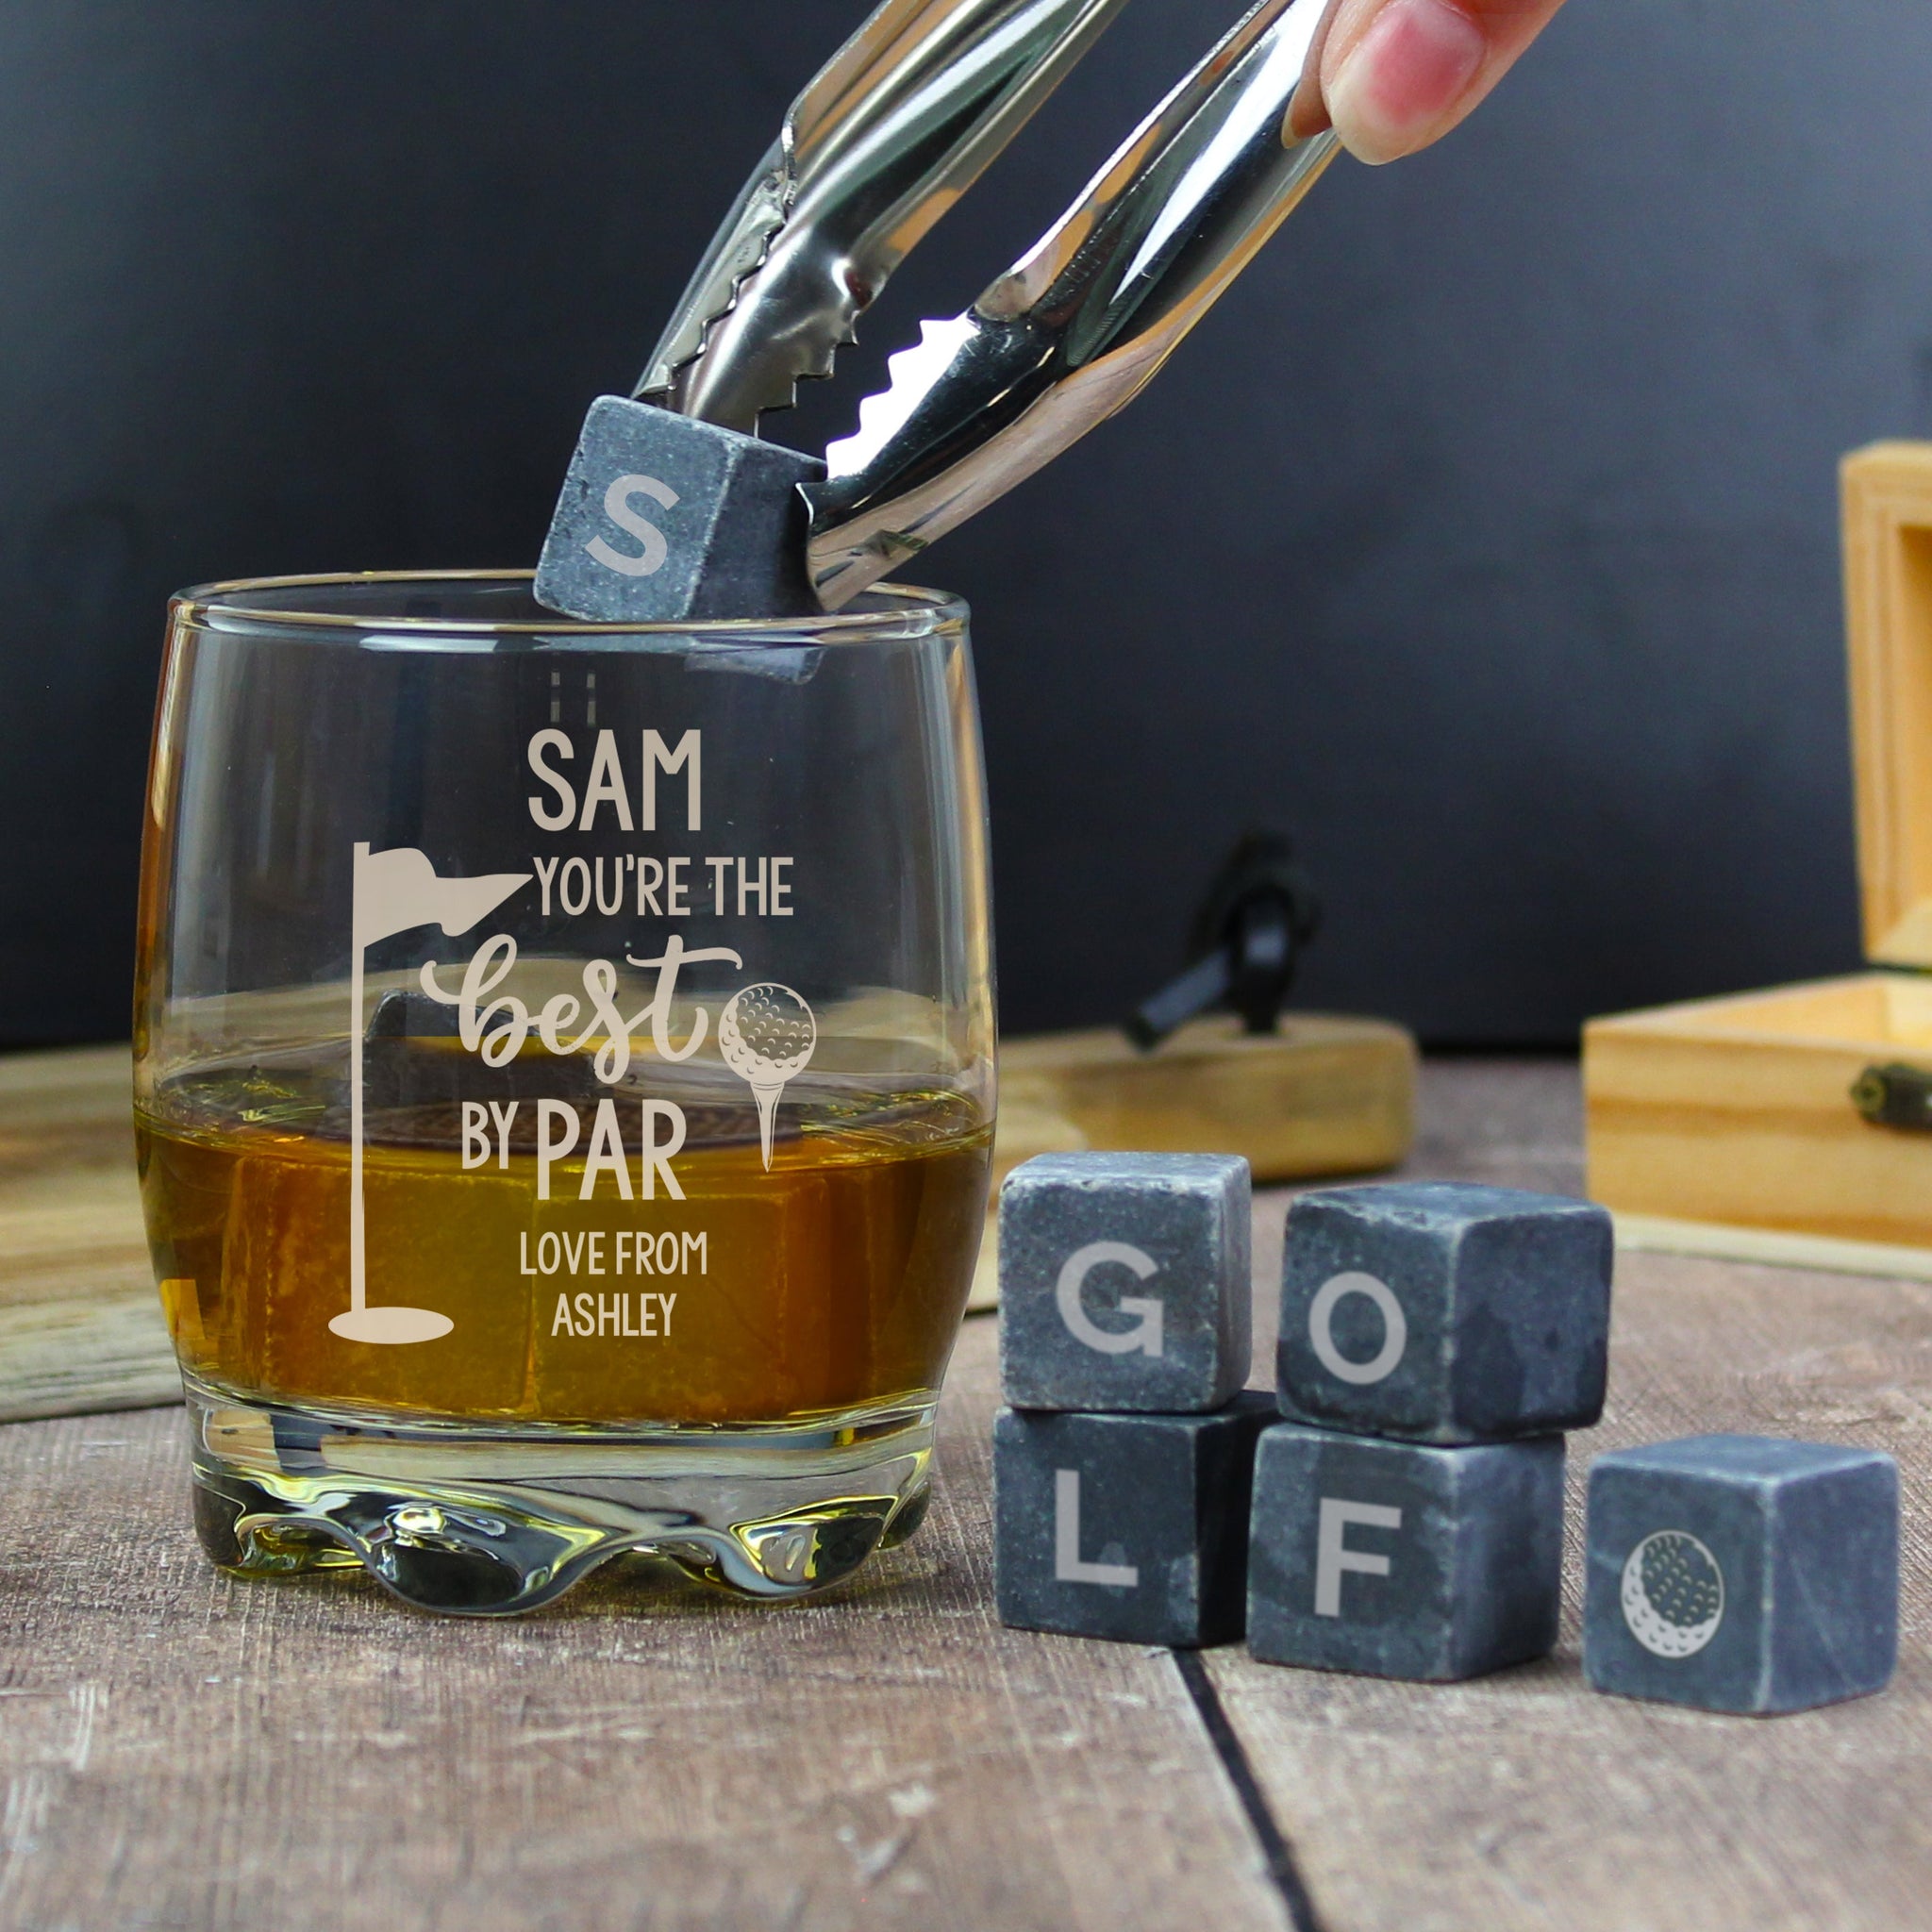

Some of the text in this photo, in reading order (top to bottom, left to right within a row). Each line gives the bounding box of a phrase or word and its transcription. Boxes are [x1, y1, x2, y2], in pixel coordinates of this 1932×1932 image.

[585, 474, 680, 576] S
[527, 728, 701, 831] SAM
[533, 854, 793, 916] YOU'RE THE
[420, 934, 742, 1085] best
[462, 1098, 687, 1201] BY PAR
[520, 1231, 708, 1275] LOVE FROM
[551, 1292, 677, 1337] ASHLEY
